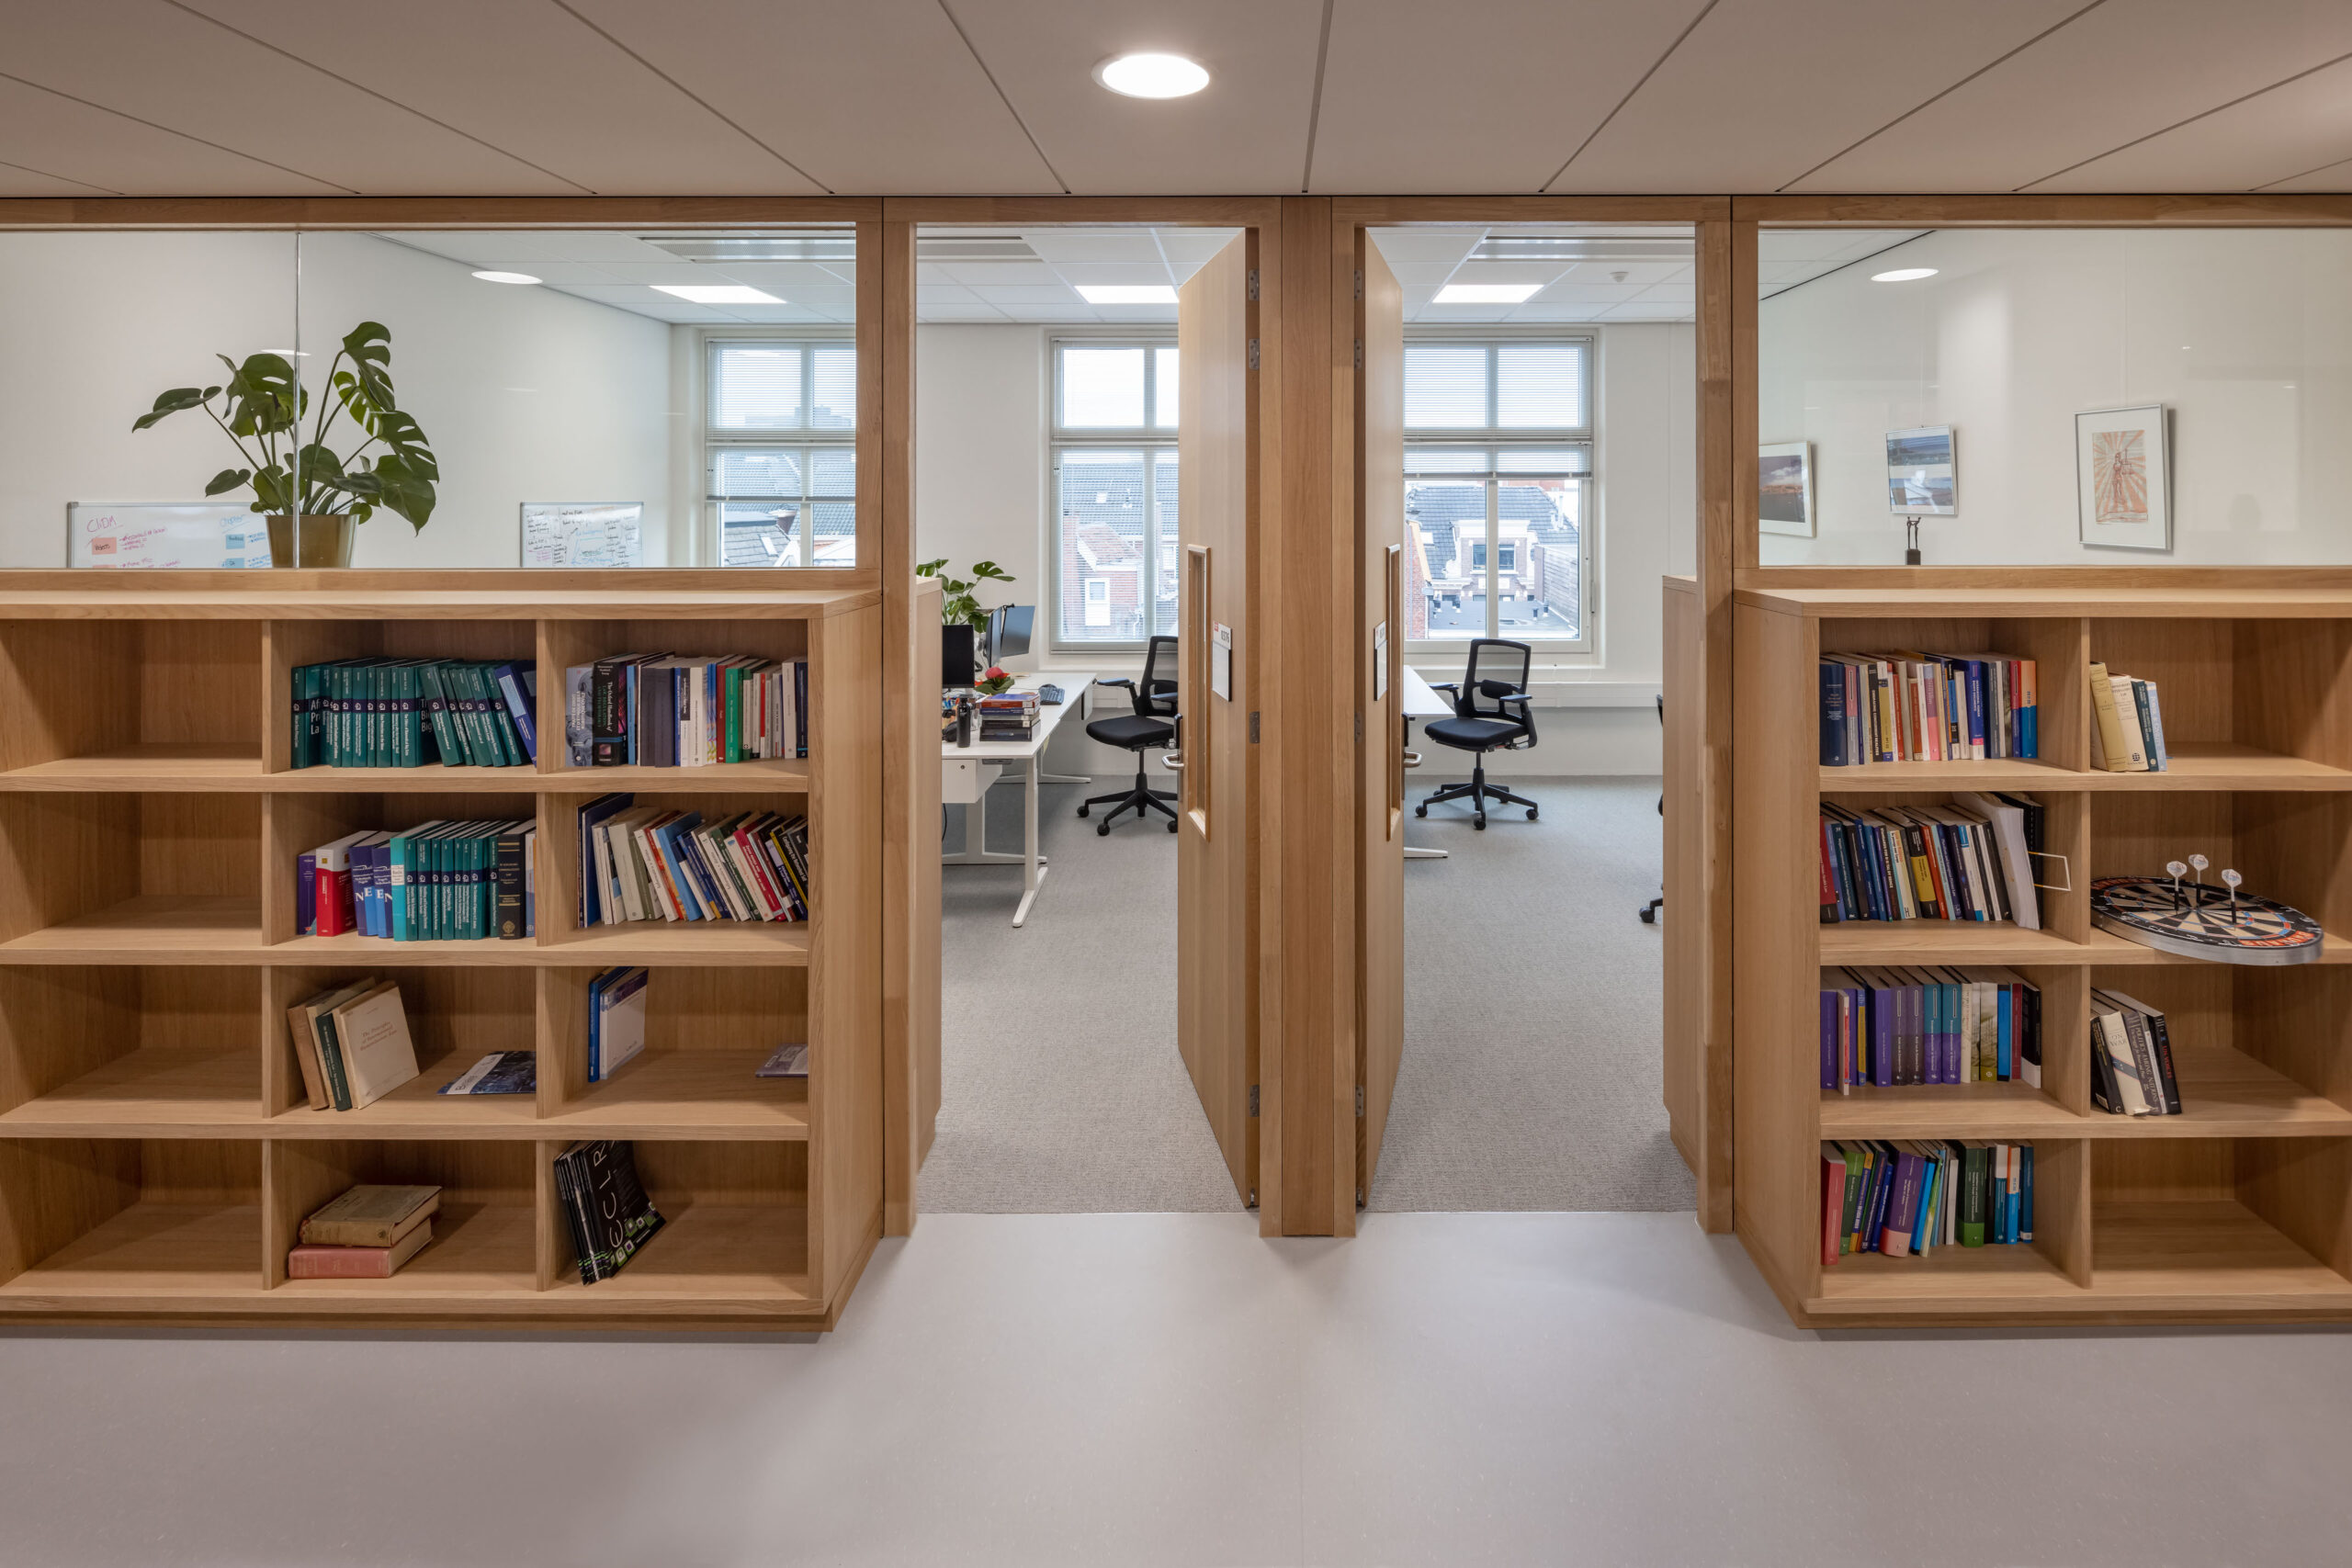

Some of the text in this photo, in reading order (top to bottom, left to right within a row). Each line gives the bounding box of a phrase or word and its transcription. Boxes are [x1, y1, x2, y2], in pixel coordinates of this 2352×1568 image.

[355, 886, 373, 902] N E
[377, 888, 384, 899] E
